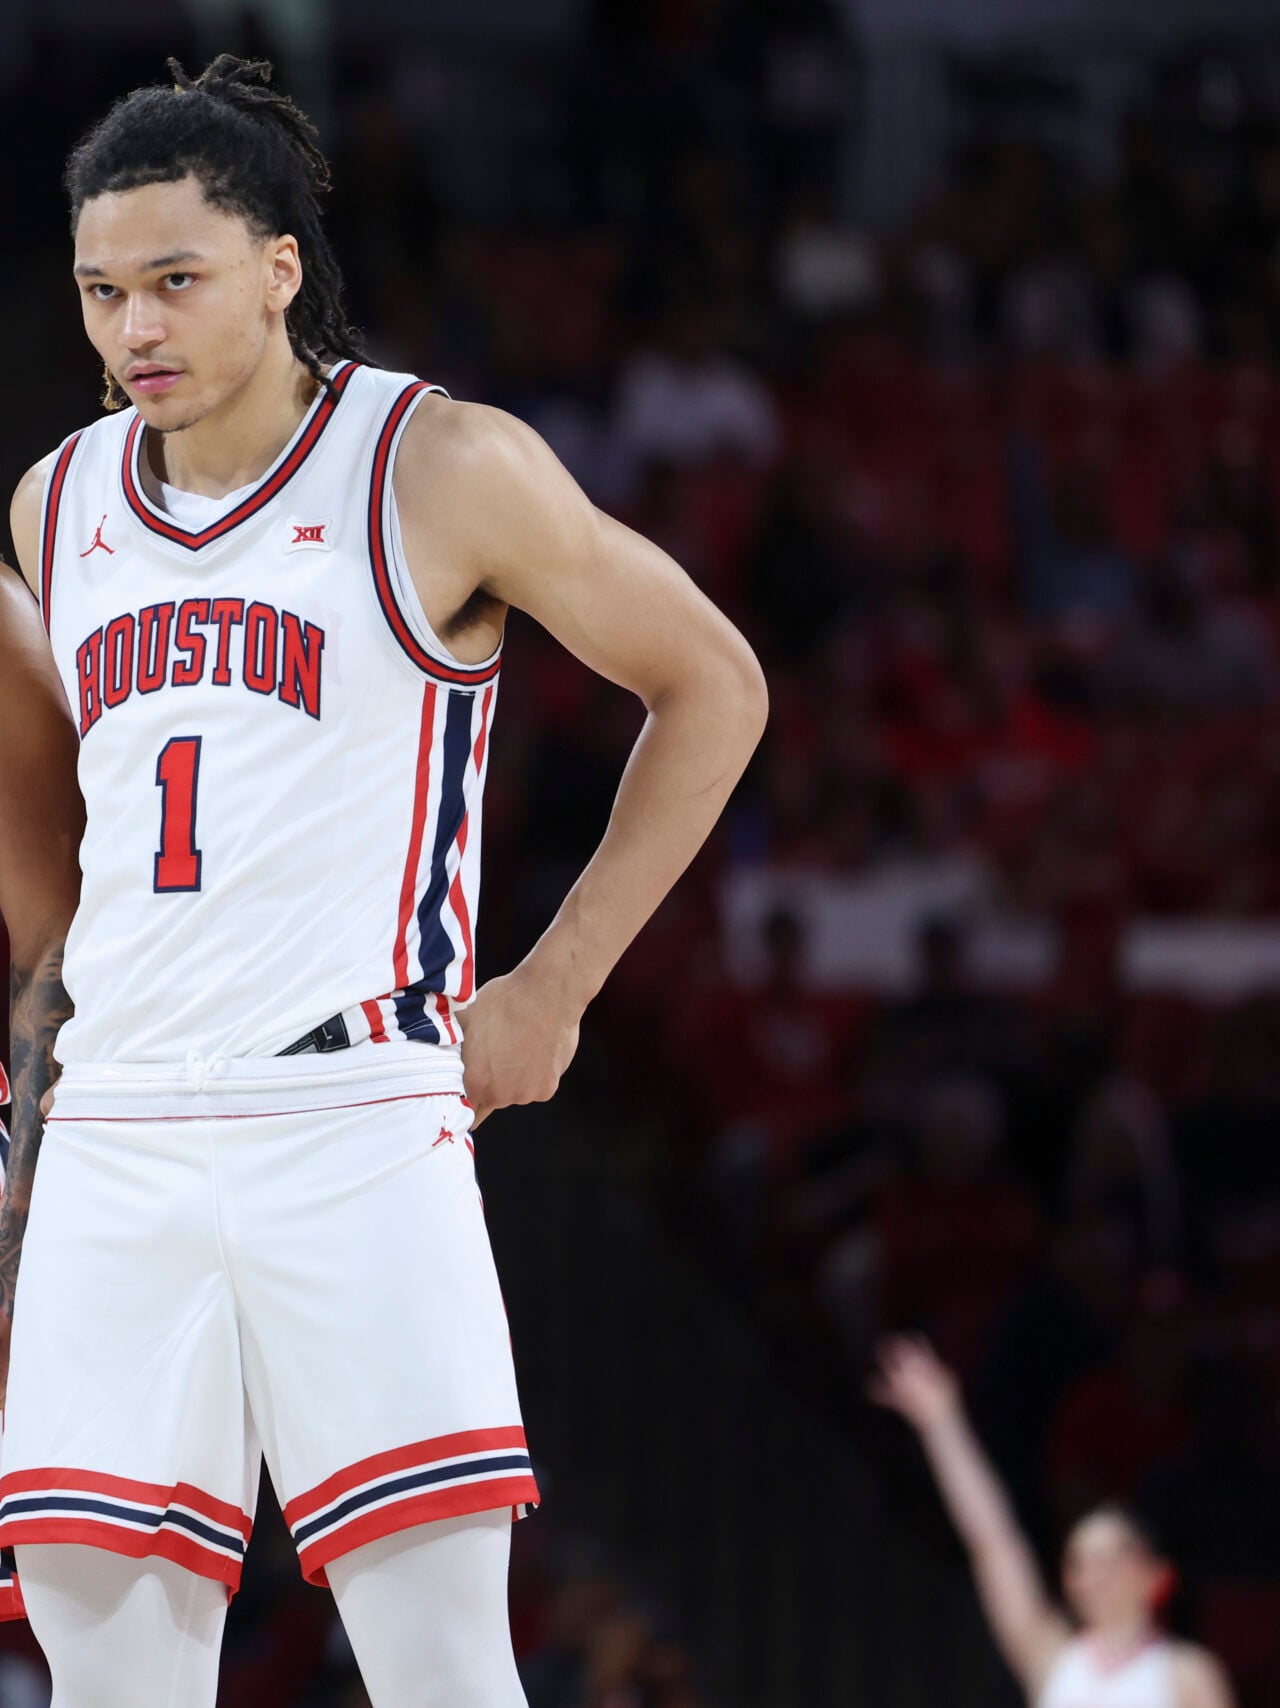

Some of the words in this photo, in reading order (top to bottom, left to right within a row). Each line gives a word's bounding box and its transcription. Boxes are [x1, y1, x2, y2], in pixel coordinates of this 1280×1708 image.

[291, 525, 325, 543] XII
[76, 597, 325, 740] HOUSTON
[153, 735, 202, 893] 1
